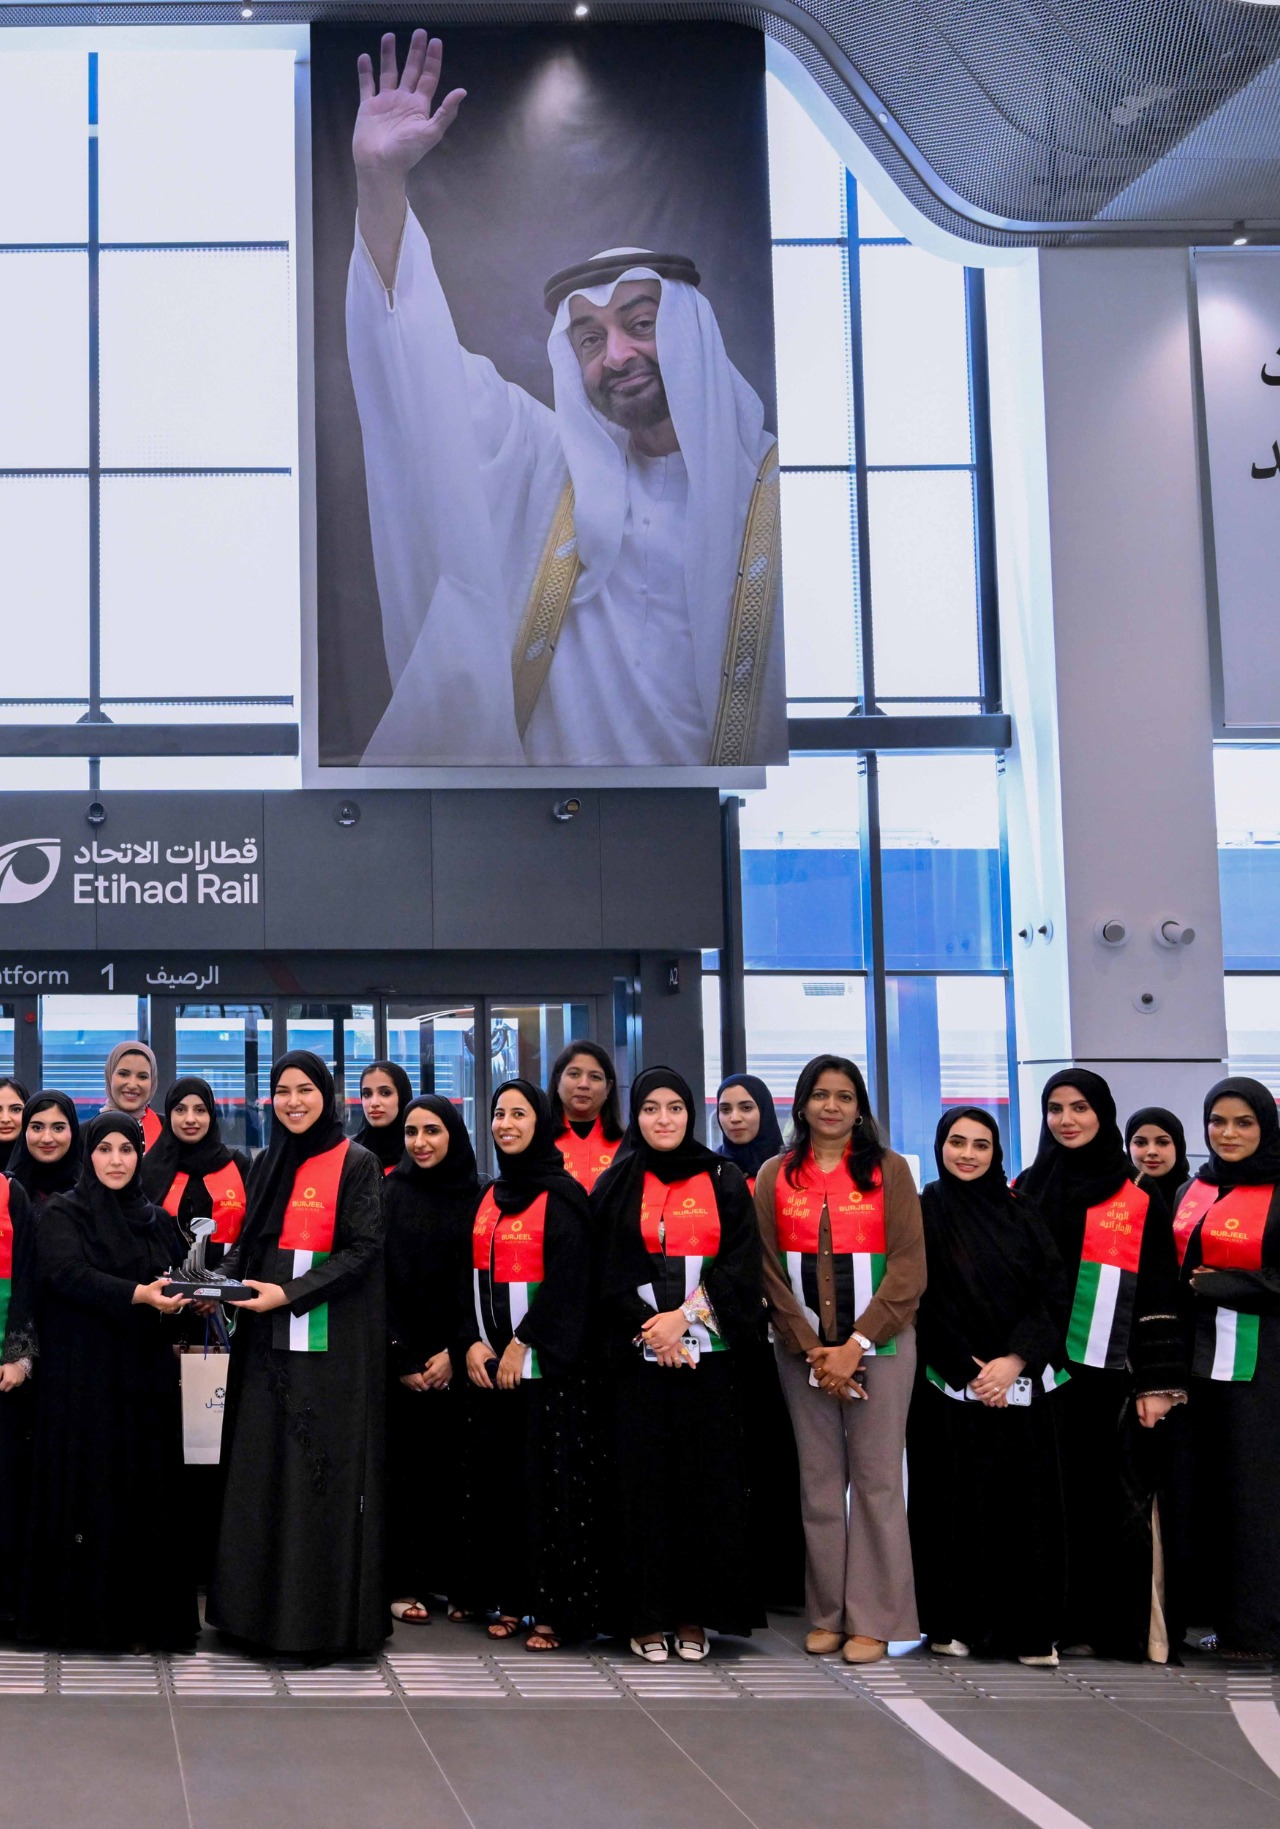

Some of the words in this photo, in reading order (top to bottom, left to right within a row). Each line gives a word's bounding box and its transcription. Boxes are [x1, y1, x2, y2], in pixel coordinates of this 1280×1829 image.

[73, 841, 159, 864] الاتحاد
[166, 837, 258, 871] قطارات
[73, 873, 187, 904] Etihad
[198, 873, 259, 904] Rail
[100, 963, 114, 990] 1
[146, 966, 219, 990] الرصيف
[669, 967, 678, 985] A2
[292, 1201, 325, 1209] BURJEEL
[838, 1204, 875, 1212] BURJEEL
[501, 1233, 533, 1241] BURJEEL
[1210, 1229, 1249, 1240] BURJEEL
